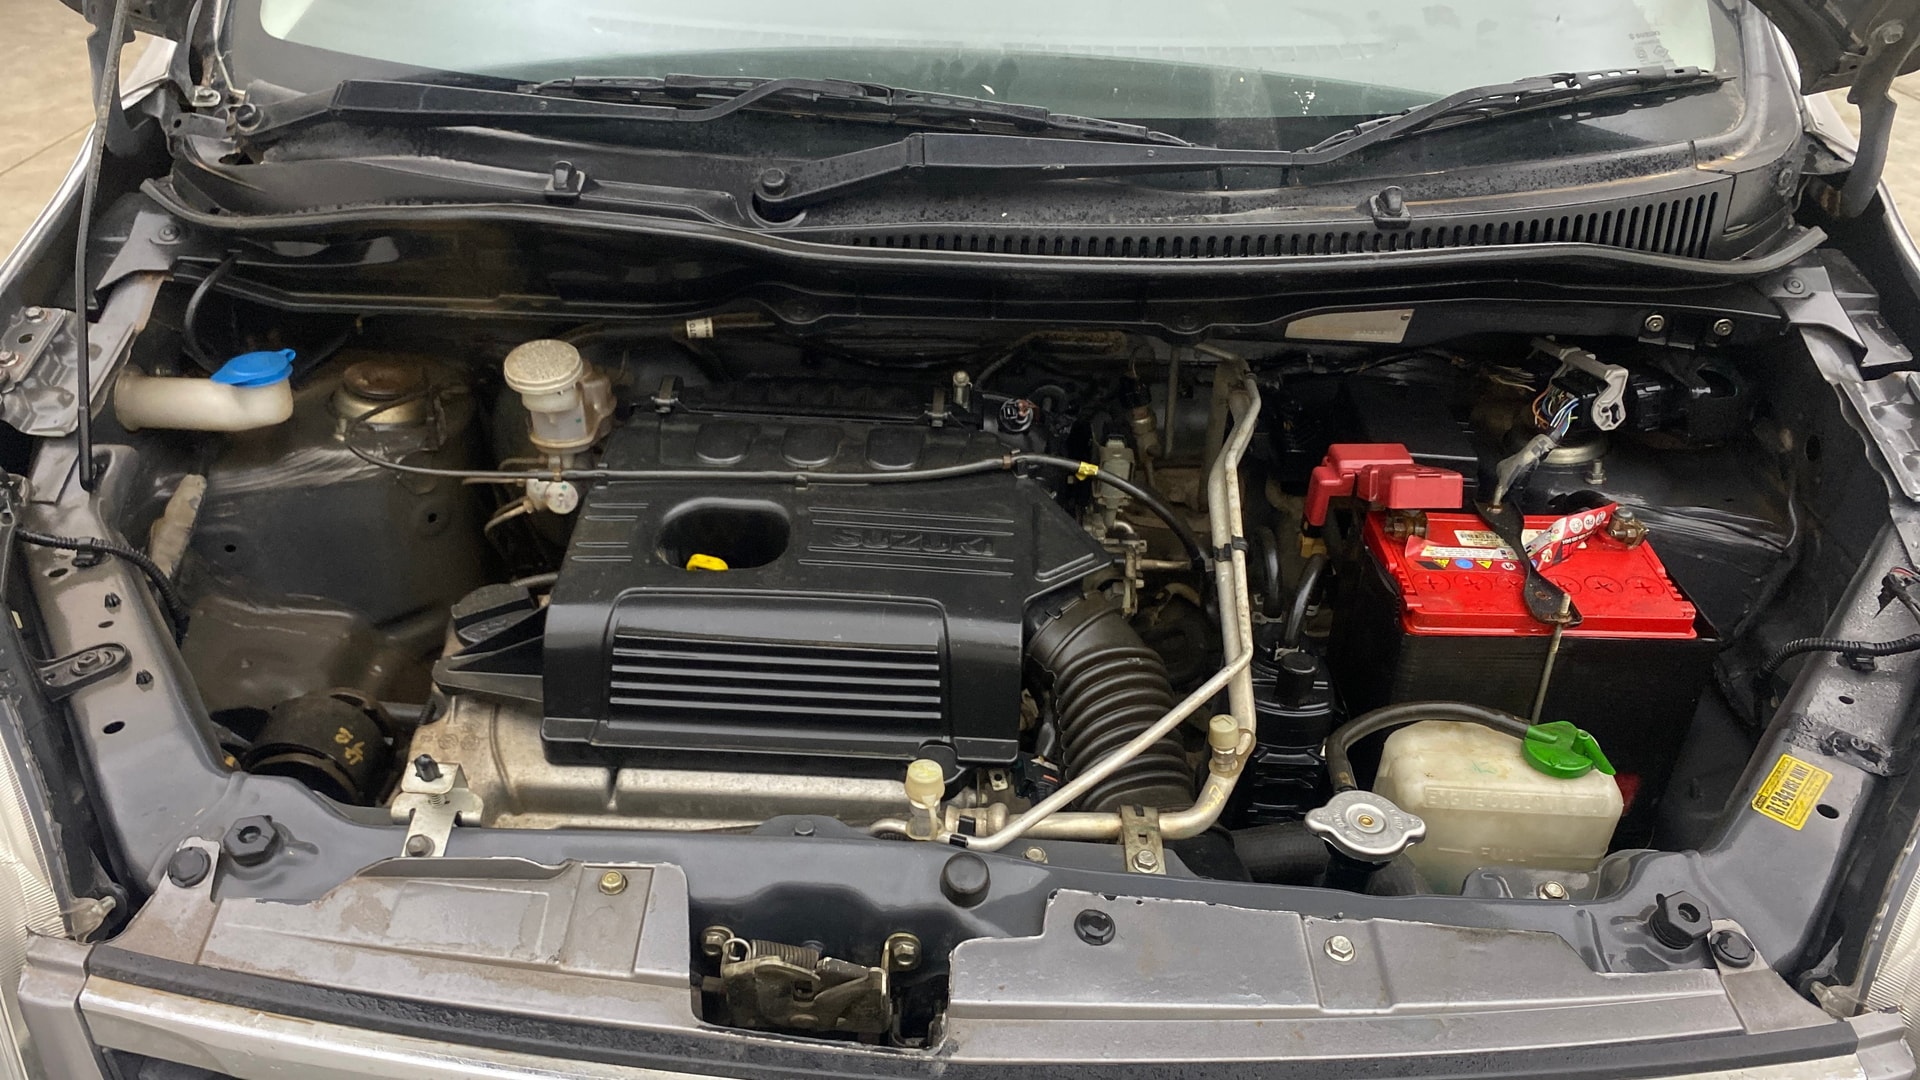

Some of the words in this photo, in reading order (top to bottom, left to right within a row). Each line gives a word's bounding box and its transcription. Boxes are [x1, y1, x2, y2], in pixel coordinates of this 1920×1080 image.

[831, 530, 996, 556] SUZUKI
[1781, 776, 1801, 793] USE
[1480, 846, 1527, 862] FULL
